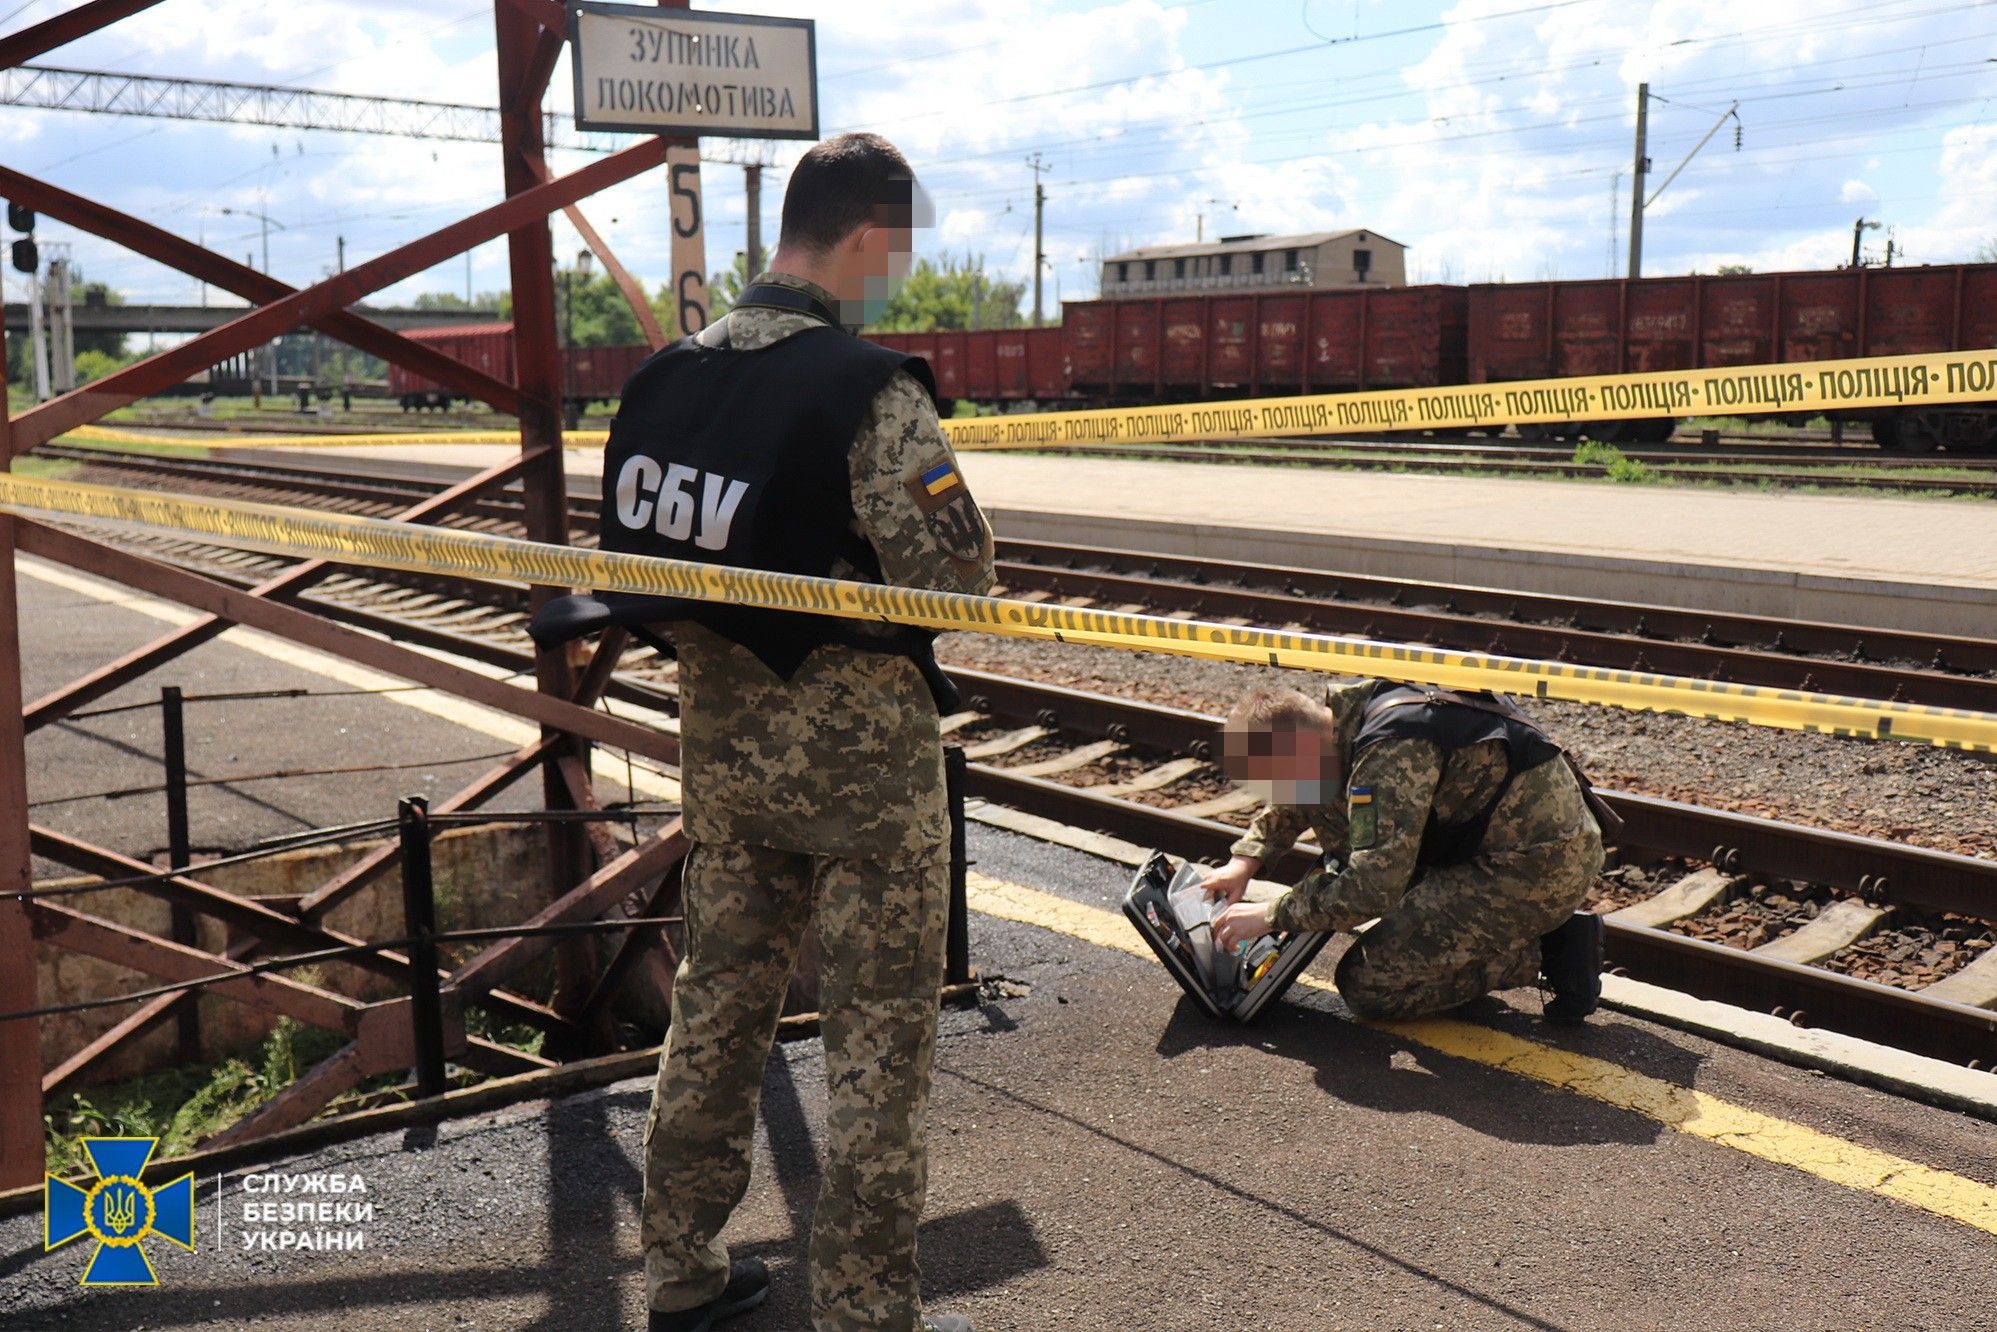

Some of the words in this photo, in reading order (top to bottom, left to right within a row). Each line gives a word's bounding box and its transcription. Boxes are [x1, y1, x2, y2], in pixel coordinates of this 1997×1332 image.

[628, 27, 760, 69] ЗУПИНКА
[597, 77, 796, 119] ЛОКОМОТИВА
[672, 163, 700, 239] 5
[677, 270, 706, 336] 6
[1065, 416, 1118, 442] ПОЛІЦІЯ
[1126, 413, 1184, 438] ПОЛІЦІЯ
[1191, 408, 1254, 435] ПОЛІЦІЯ
[1261, 404, 1328, 431] ПОЛІЦІЯ
[1337, 398, 1408, 427] ПОЛІЦІЯ
[1418, 393, 1495, 423] ПОЛІЦІЯ
[1505, 387, 1589, 418] ПОЛІЦІЯ
[1600, 381, 1691, 414] ПОЛІЦІЯ
[1704, 373, 1804, 408] ПОЛІЦІЯ
[1819, 365, 1929, 402] ПОЛІЦІЯ
[615, 454, 750, 551] СБУ
